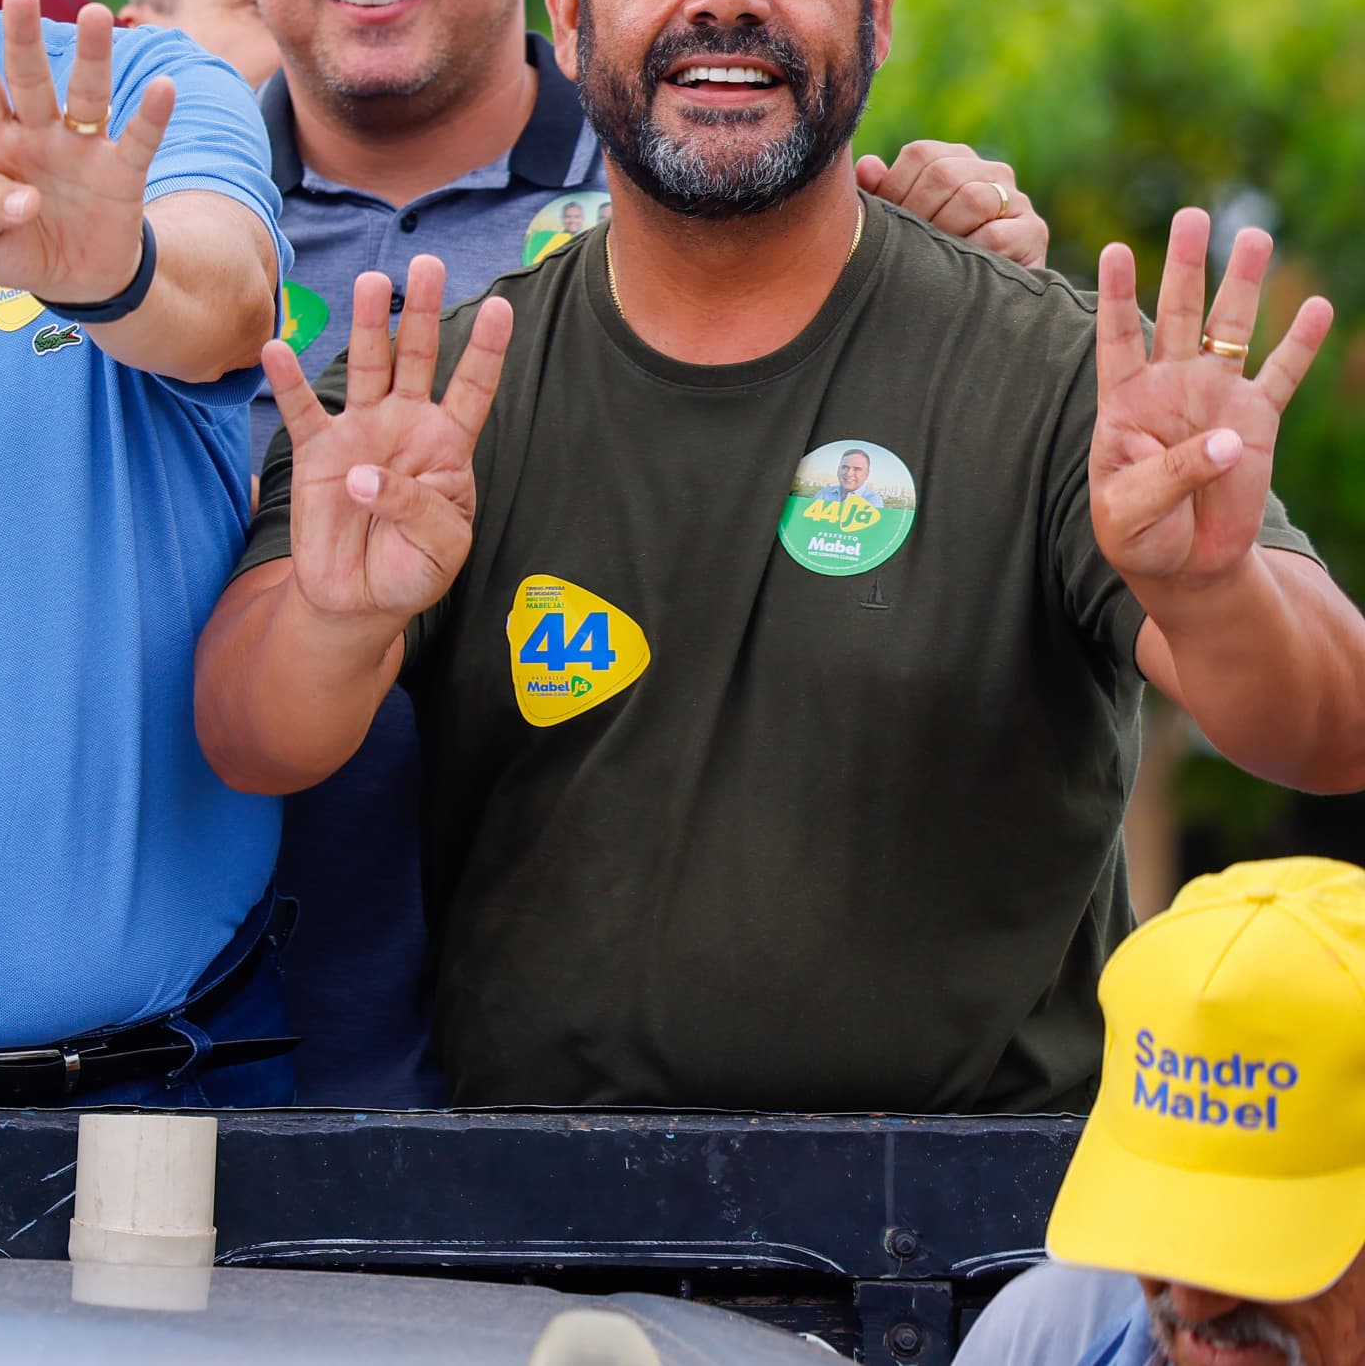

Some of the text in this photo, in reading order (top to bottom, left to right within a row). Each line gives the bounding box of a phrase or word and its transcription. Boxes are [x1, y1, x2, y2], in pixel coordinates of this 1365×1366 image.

[803, 499, 872, 527] 44 Já
[808, 537, 861, 556] Mabel
[818, 532, 858, 541] PREFEITO
[520, 612, 616, 671] 44
[527, 681, 570, 691] Mabel
[1135, 1027, 1299, 1090] Sandro
[1133, 1071, 1278, 1132] Mabel
